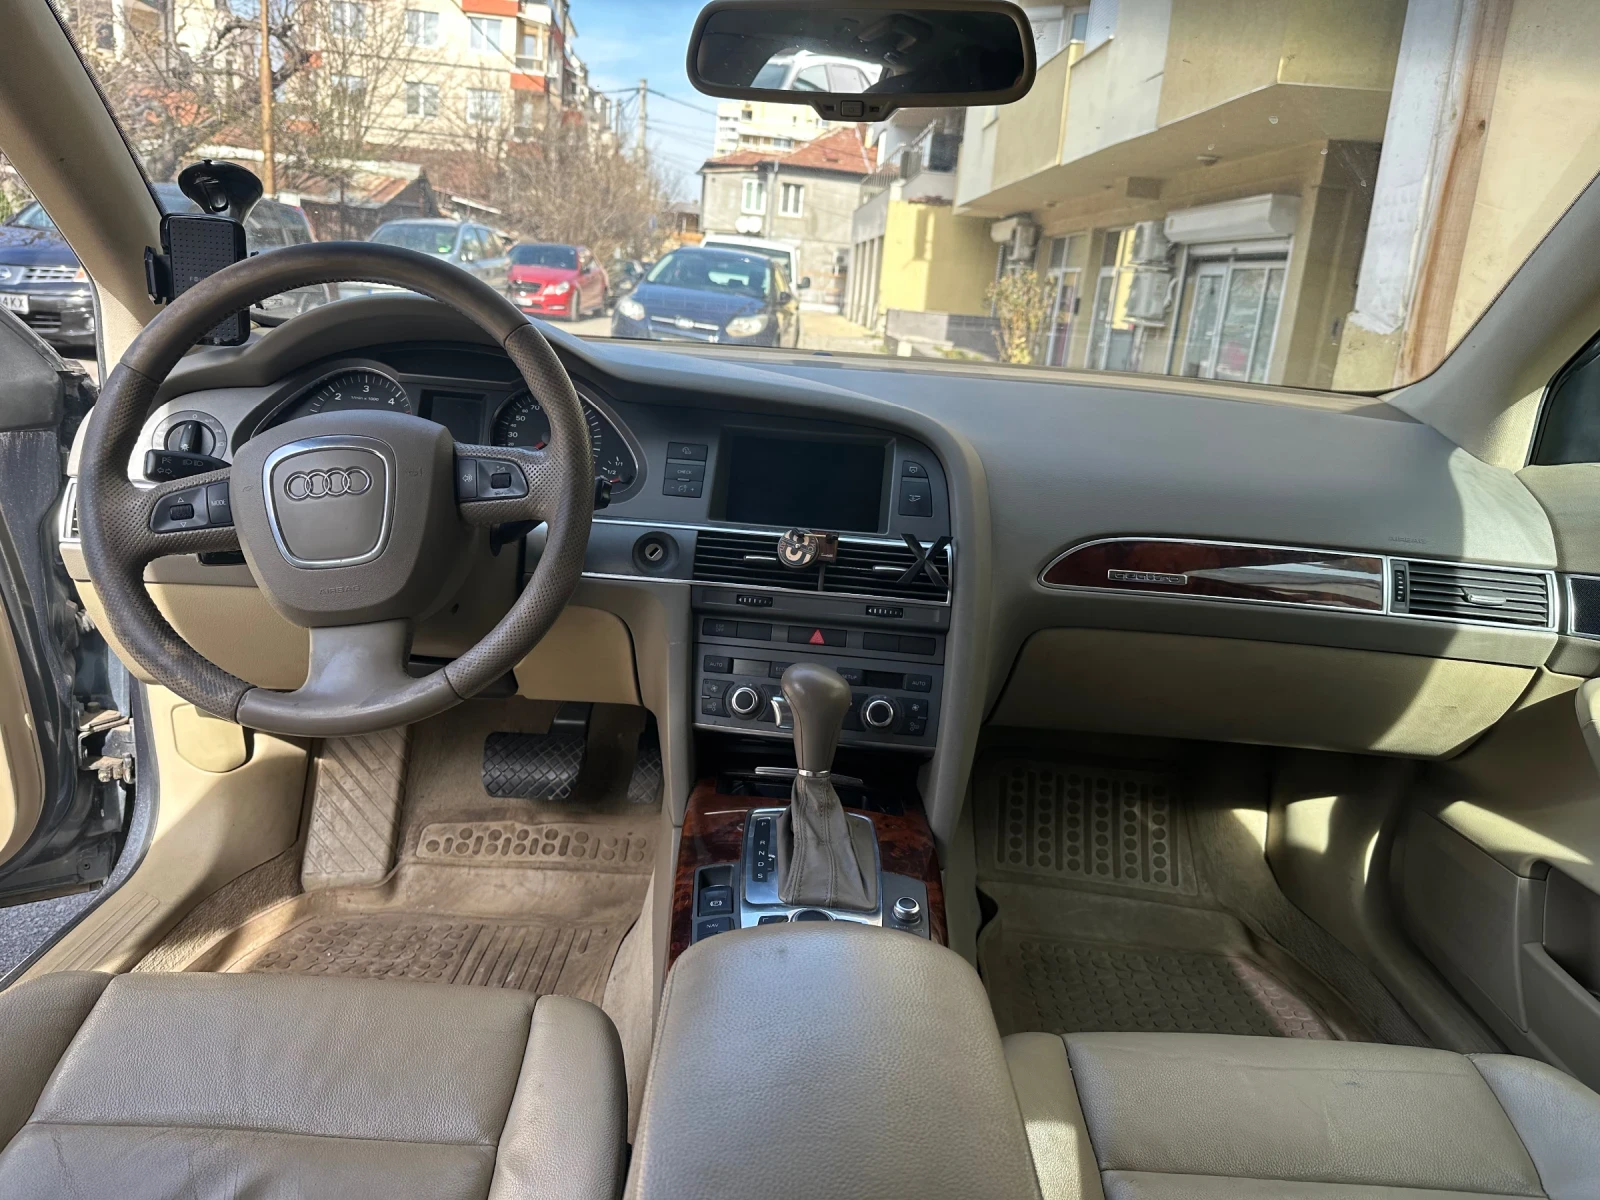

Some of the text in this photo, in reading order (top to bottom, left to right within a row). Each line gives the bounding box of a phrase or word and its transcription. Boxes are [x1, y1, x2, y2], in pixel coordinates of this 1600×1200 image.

[362, 385, 370, 393] 3
[334, 392, 342, 401] 2
[387, 397, 395, 406] 4
[210, 499, 227, 507] MODE
